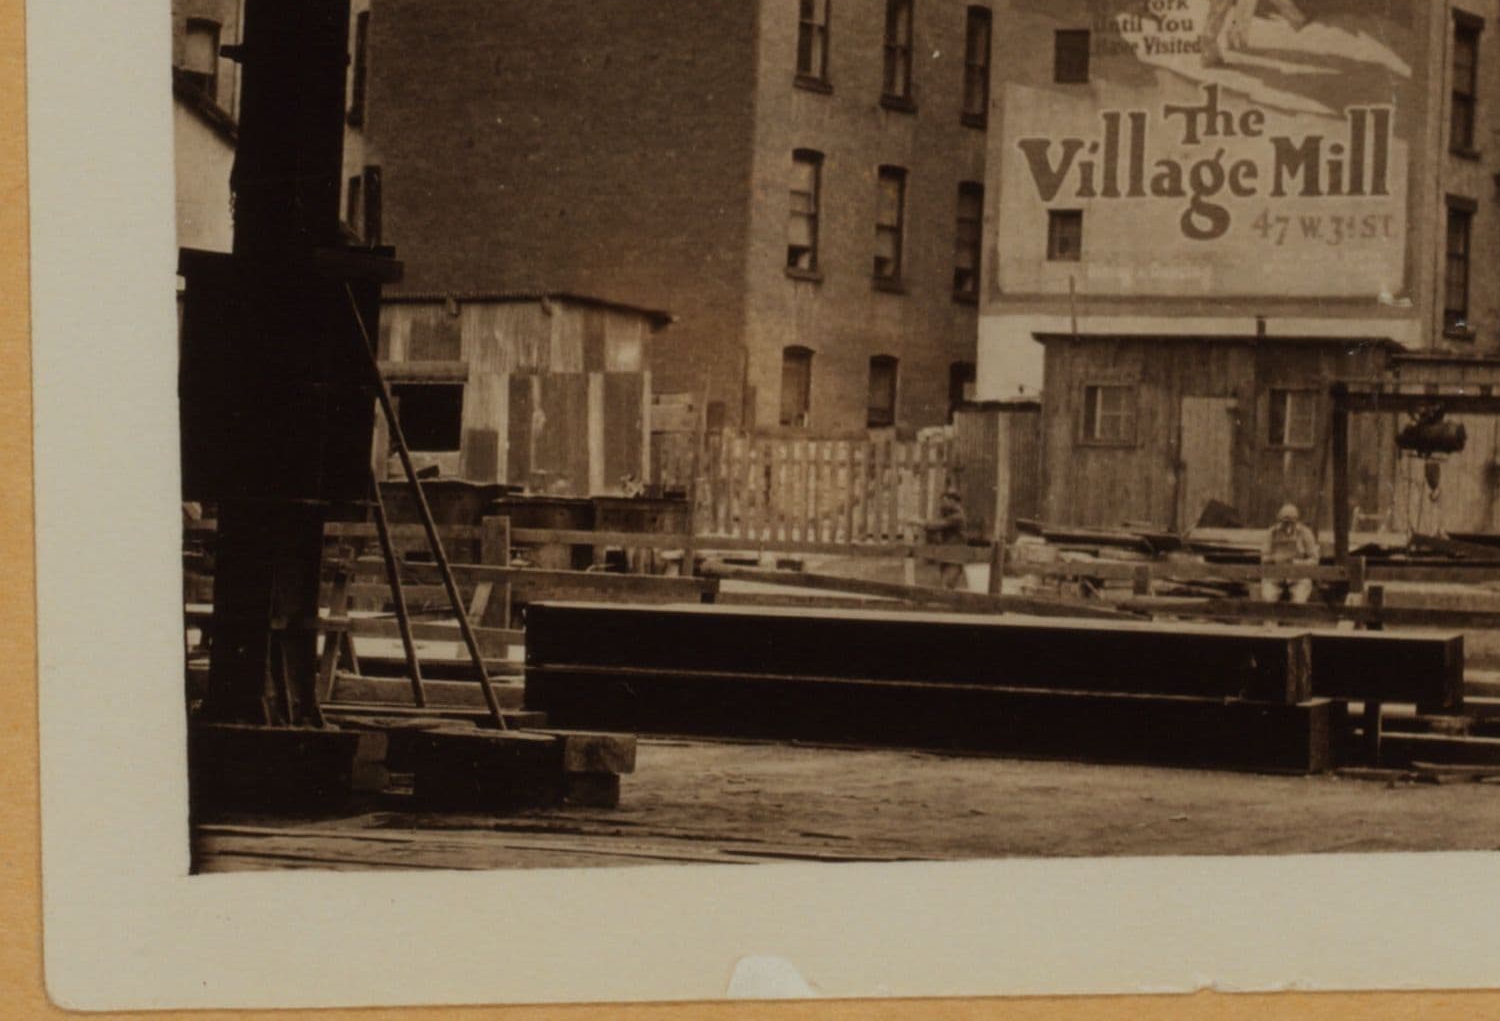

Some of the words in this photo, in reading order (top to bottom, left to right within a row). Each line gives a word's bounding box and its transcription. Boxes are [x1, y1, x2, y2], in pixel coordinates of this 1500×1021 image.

[1150, 13, 1194, 33] You
[1142, 35, 1202, 55] Visited
[1163, 83, 1265, 145] The
[1017, 110, 1259, 240] Village
[1270, 106, 1393, 198] Mill
[1251, 207, 1291, 247] 47
